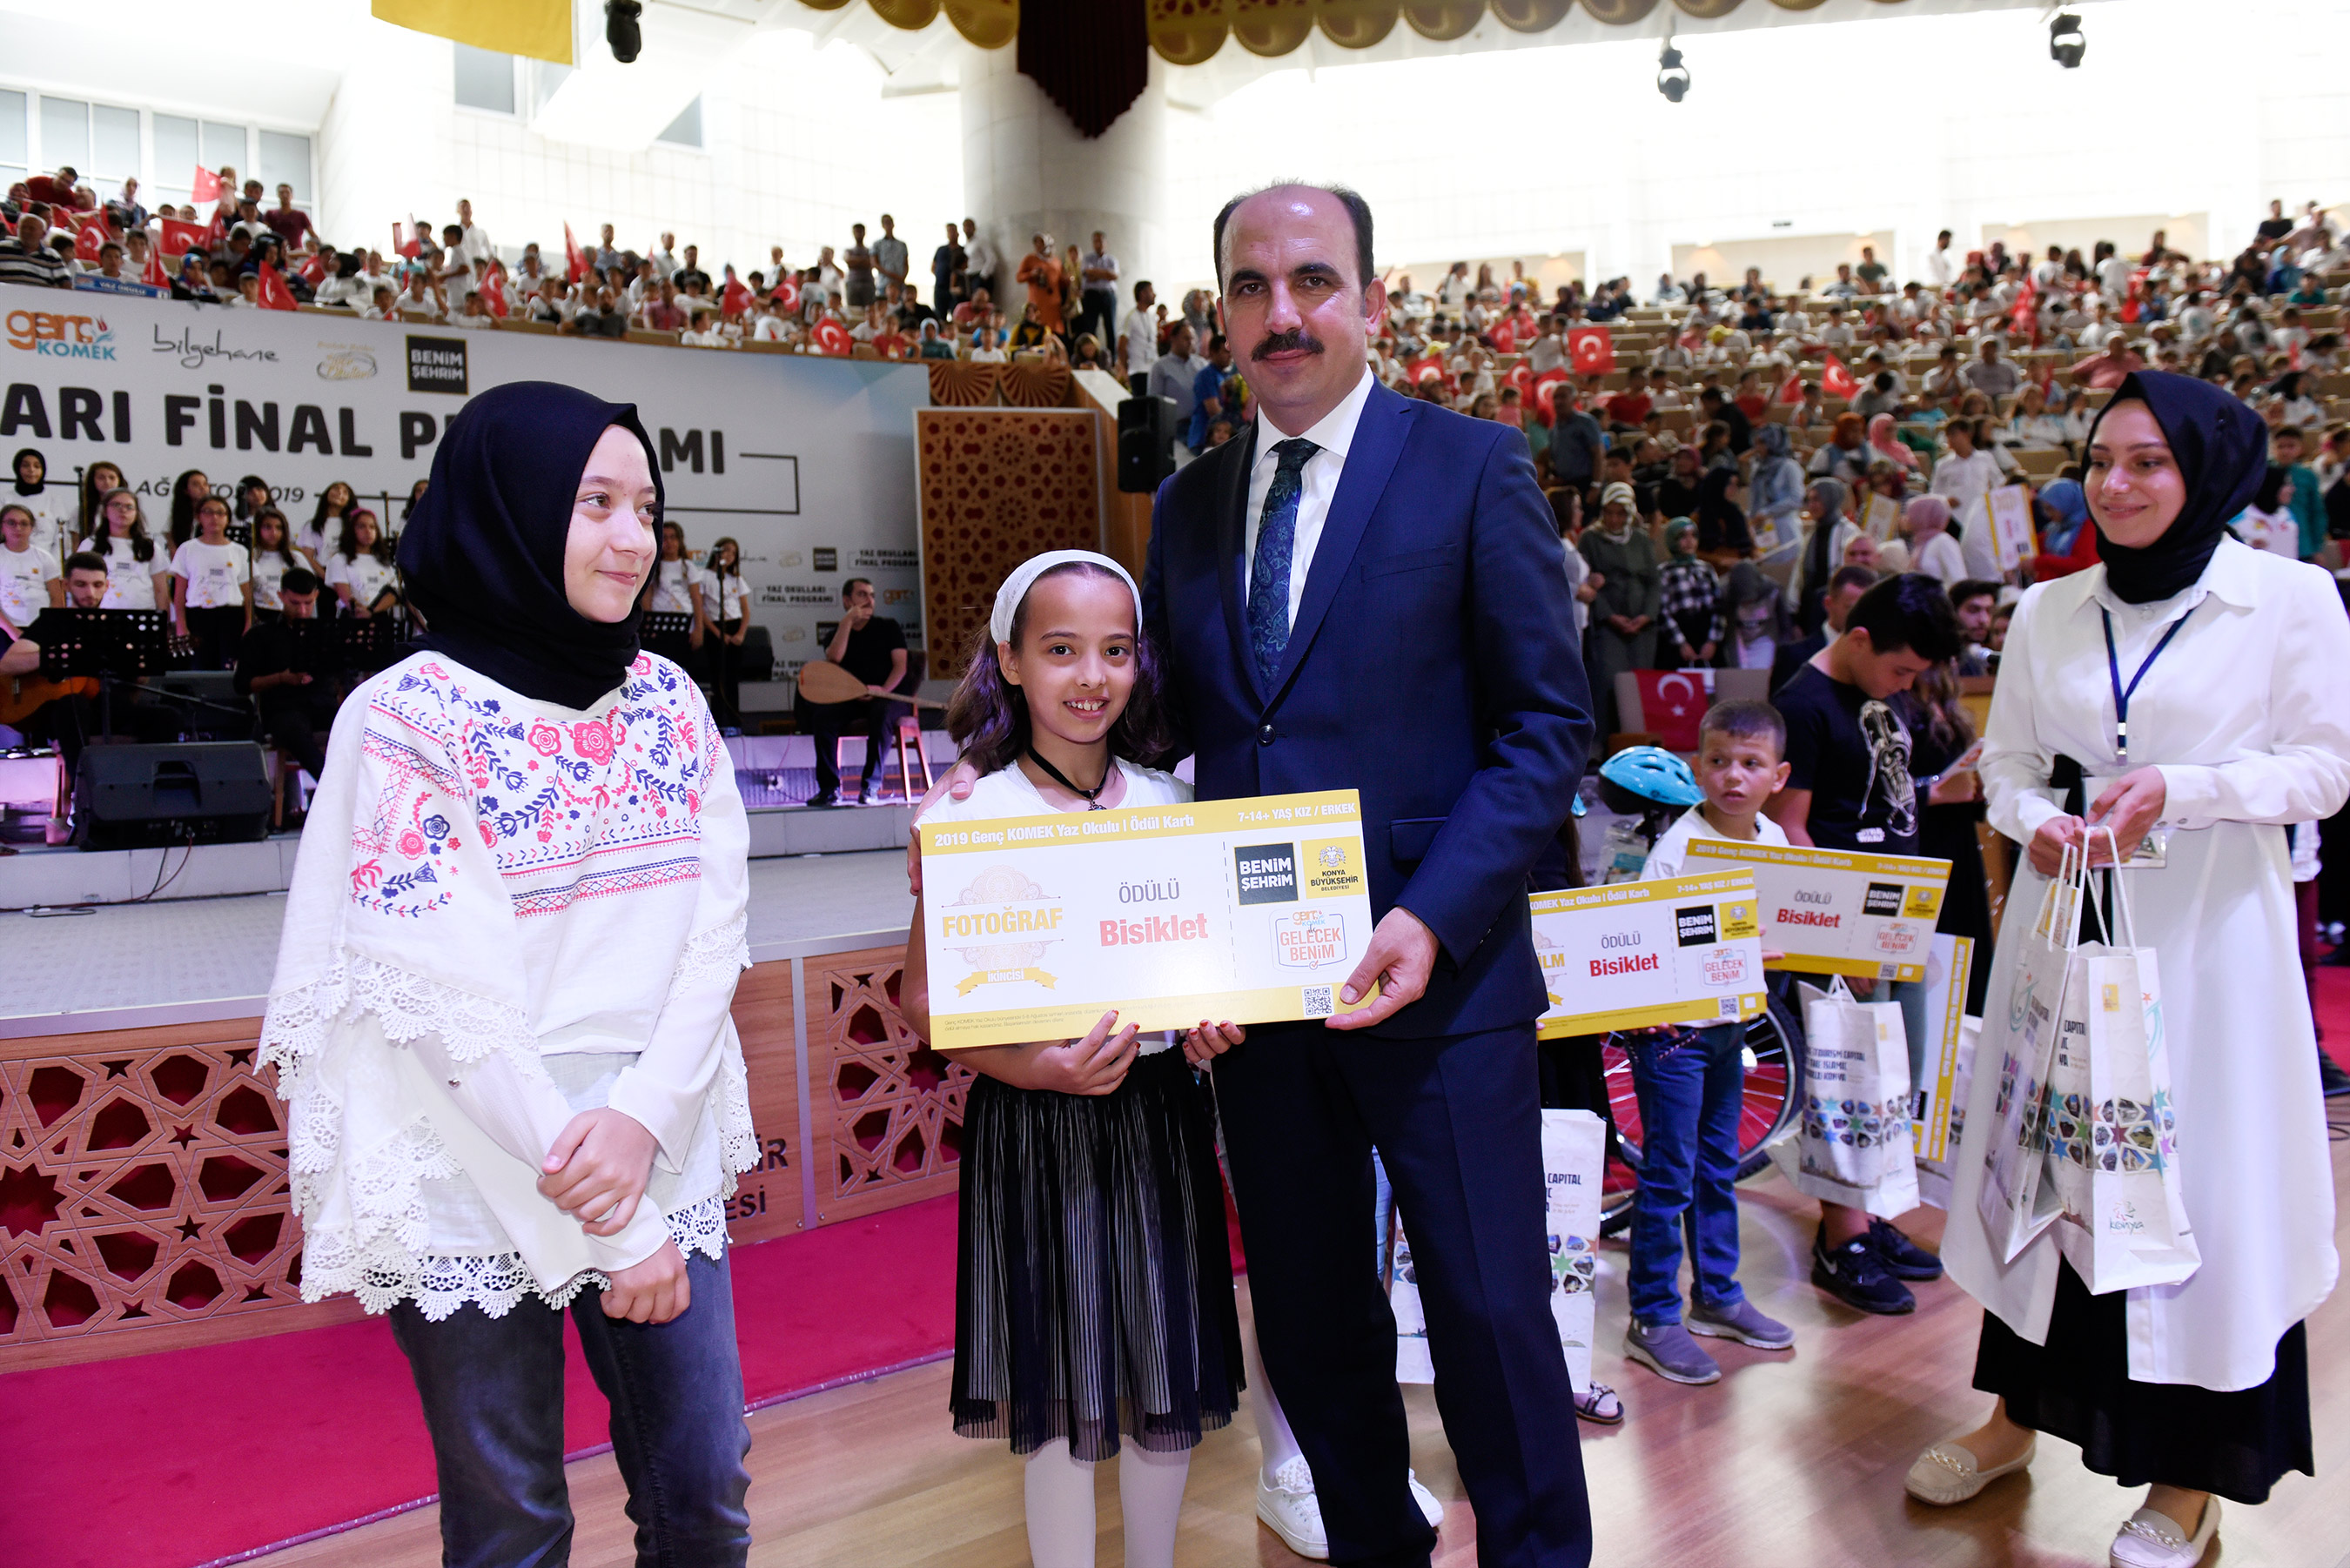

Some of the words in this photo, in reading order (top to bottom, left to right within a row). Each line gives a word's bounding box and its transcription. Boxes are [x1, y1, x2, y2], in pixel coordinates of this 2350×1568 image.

[6, 310, 92, 350] genç
[36, 340, 117, 361] KOMEK
[152, 324, 279, 369] bilgehane
[164, 384, 373, 457] FİNAL
[1238, 811, 1270, 822] 7-14+
[1272, 807, 1292, 821] YAŞ
[1294, 806, 1312, 818] KIZ
[1321, 802, 1356, 815] ERKEK
[934, 832, 969, 848] 2019
[971, 830, 1004, 846] Genç
[1007, 825, 1055, 842] KOMEK
[1057, 824, 1079, 838] Yaz
[1082, 819, 1120, 835] Okulu
[1130, 815, 1160, 832] Ödül
[1163, 814, 1195, 828] Kartı
[1239, 857, 1292, 875] BENİM
[1241, 874, 1293, 892] ŞEHRİM
[1310, 874, 1359, 887] BÜYÜKŞEHİR
[1118, 880, 1180, 905] ÖDÜLÜ
[1559, 897, 1574, 908] Yaz
[1576, 895, 1601, 905] Okulu
[1608, 890, 1628, 901] Ödül
[1628, 888, 1650, 899] Kartı
[1795, 888, 1832, 905] ÖDÜLÜ
[942, 905, 1064, 939] FOTOĞRAF
[1678, 914, 1713, 928] BENİM
[1777, 908, 1841, 928] Bisiklet
[1099, 912, 1209, 948] Bisiklet
[1279, 927, 1341, 947] GELECEK
[1601, 930, 1642, 949] ÖDÜLÜ
[1290, 943, 1335, 962] BENİM
[1537, 952, 1565, 969] İLM
[1589, 953, 1660, 977] Bisiklet
[1705, 958, 1744, 973] GELECEK
[1548, 1172, 1581, 1185] CAPITAL
